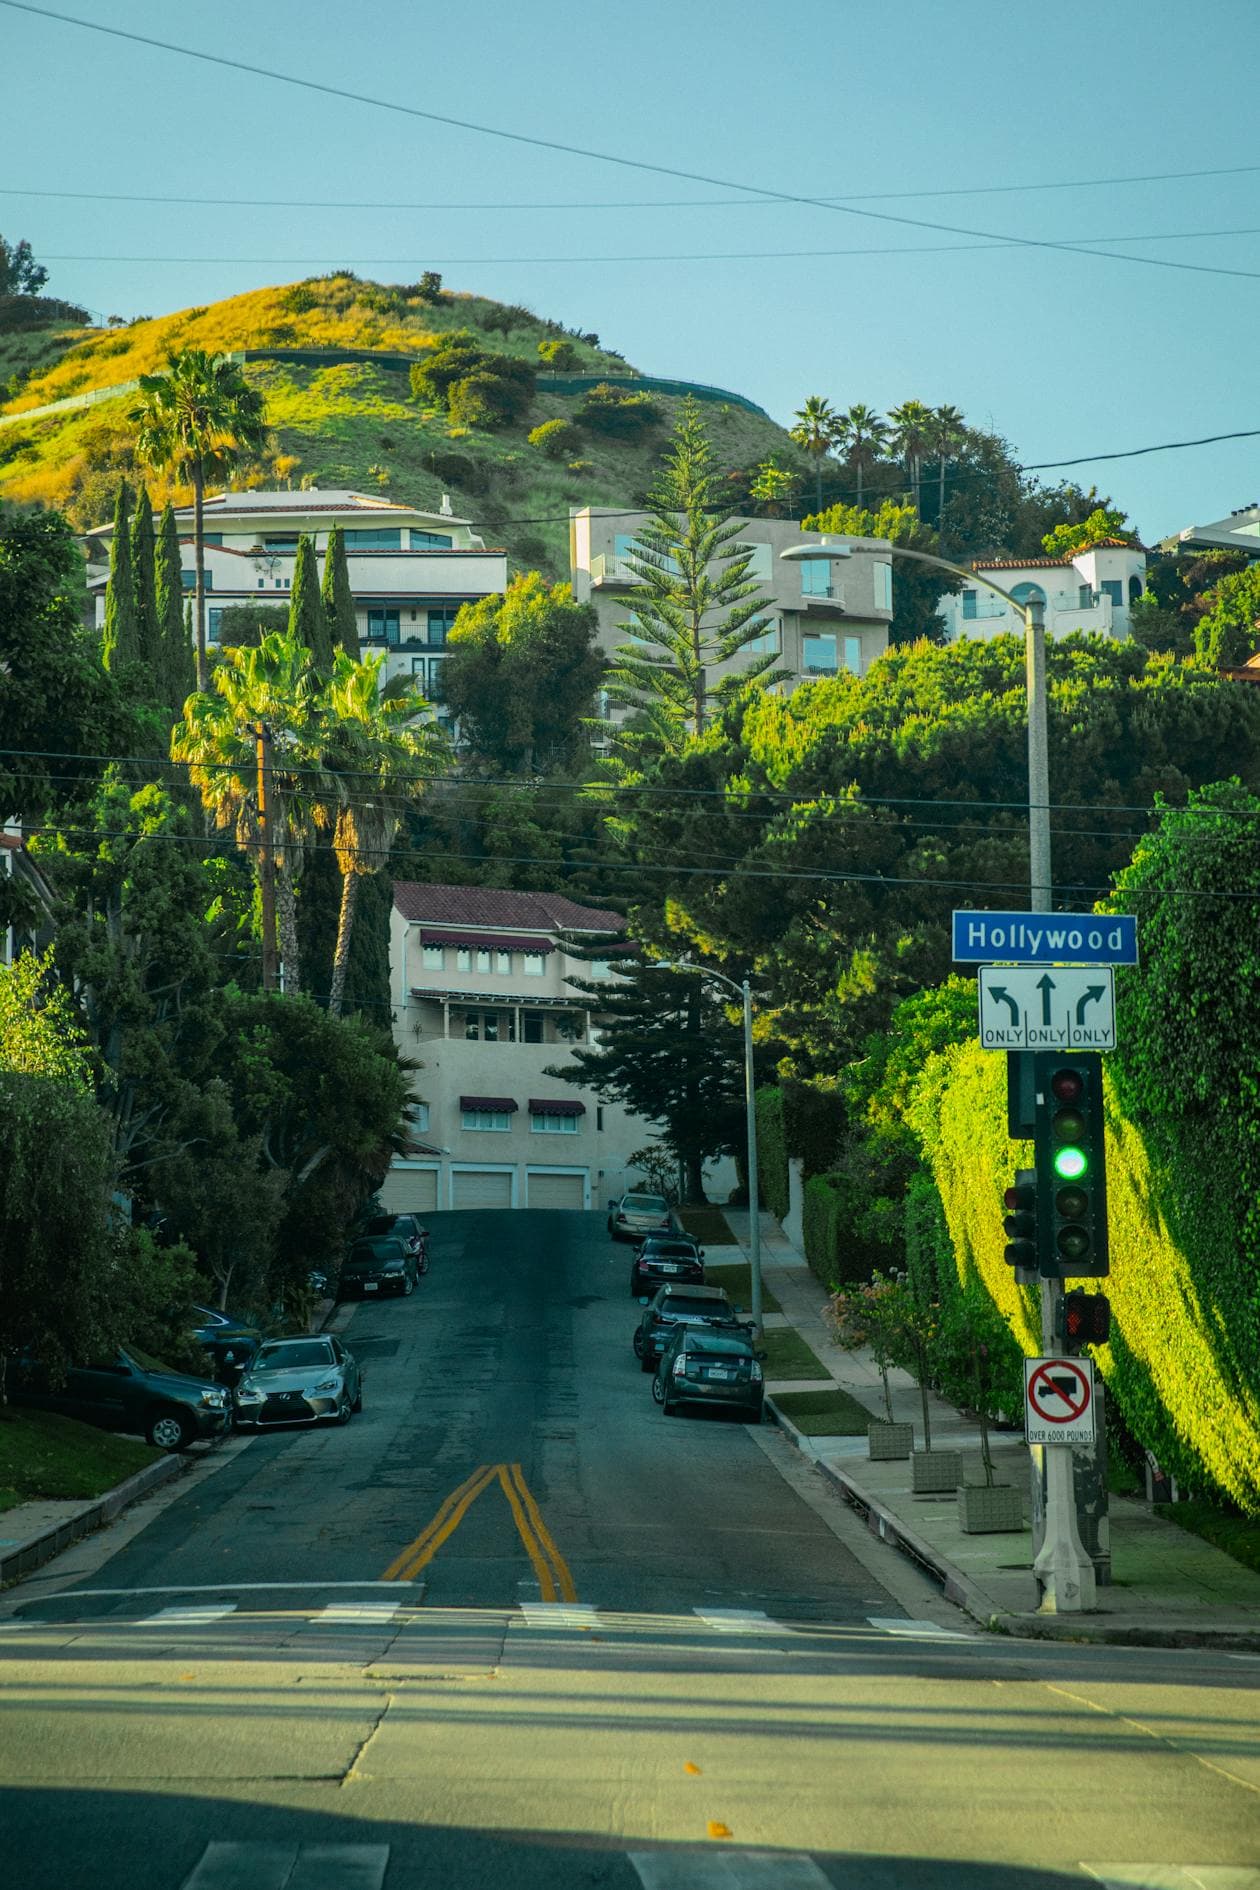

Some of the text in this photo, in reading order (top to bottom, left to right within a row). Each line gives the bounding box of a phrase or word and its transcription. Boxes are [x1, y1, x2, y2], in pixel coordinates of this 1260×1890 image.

[968, 922, 1122, 955] Hollywood
[985, 1029, 1111, 1043] ONLY ONLY ONLY
[1029, 1430, 1092, 1441] OVER 6000 POUNDS
